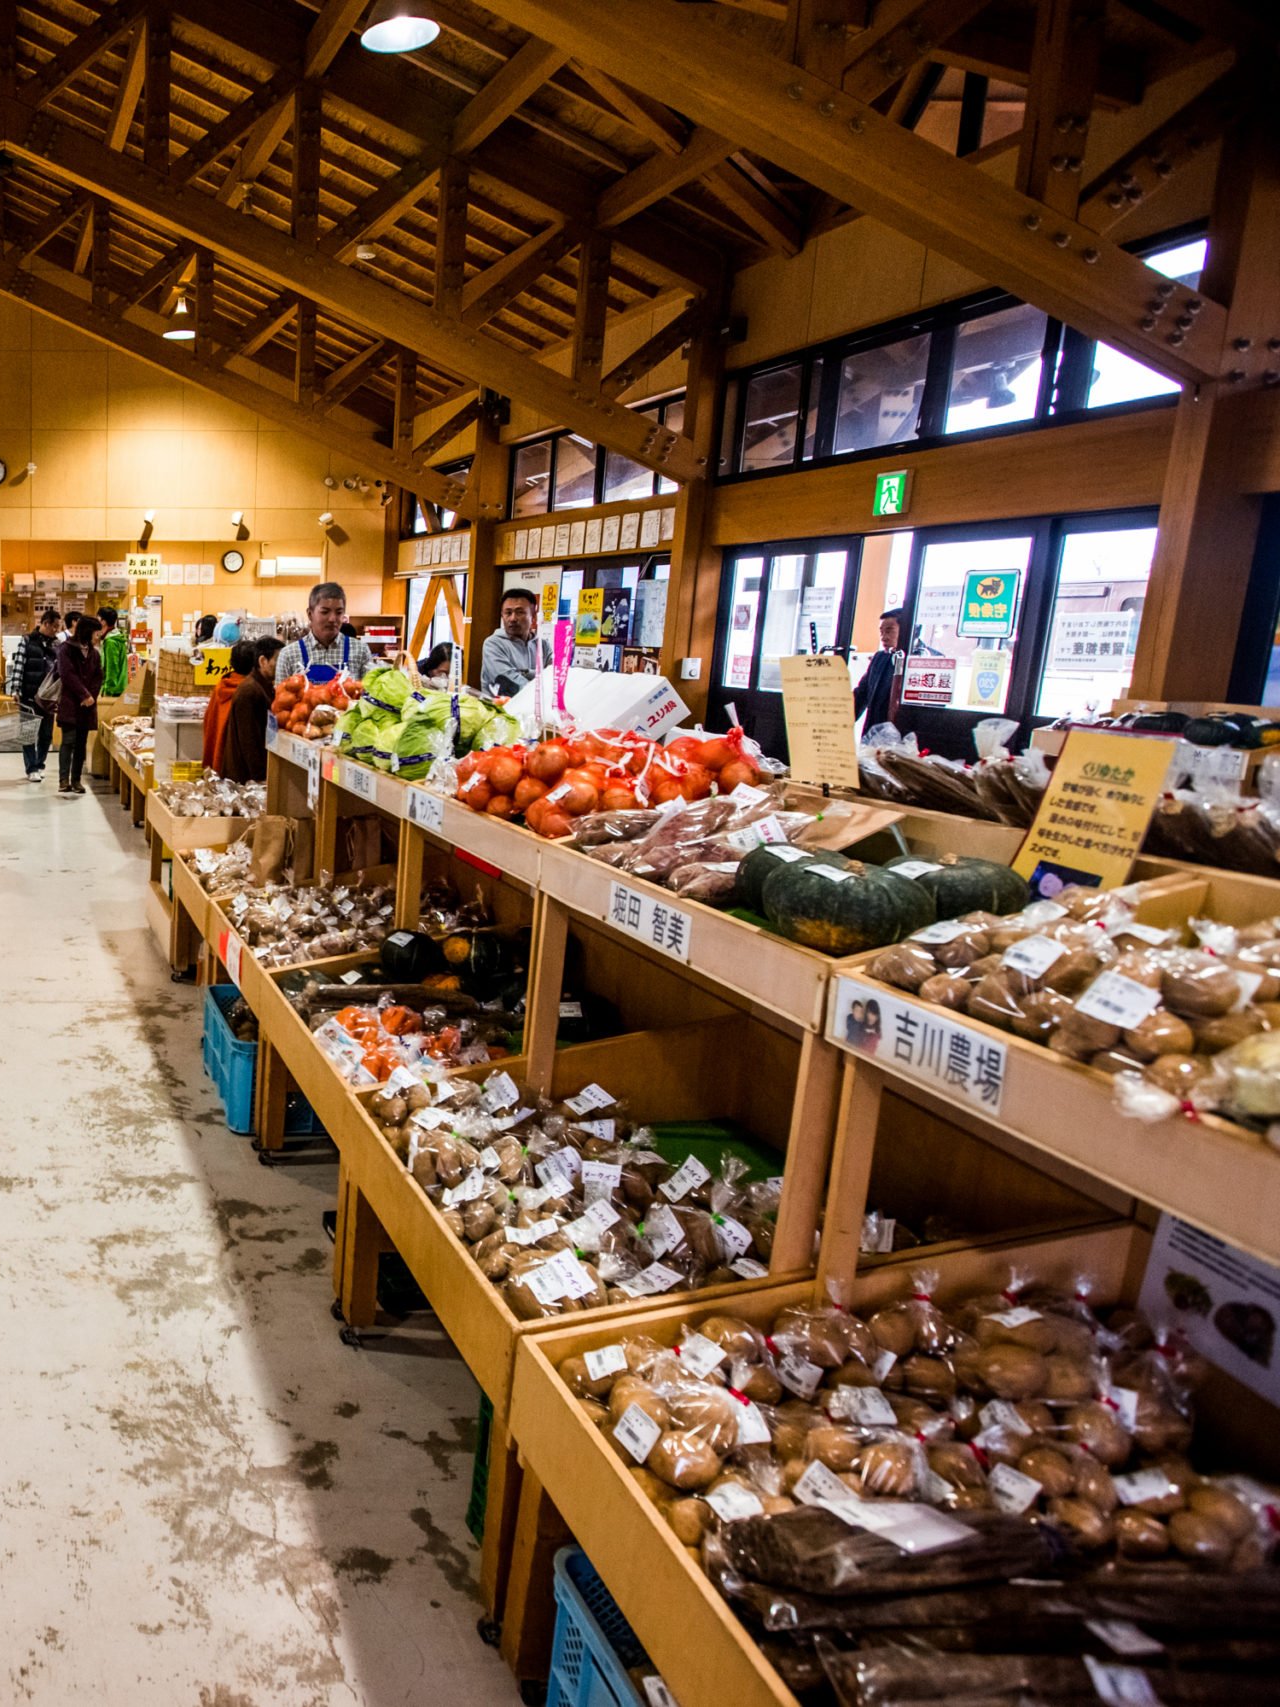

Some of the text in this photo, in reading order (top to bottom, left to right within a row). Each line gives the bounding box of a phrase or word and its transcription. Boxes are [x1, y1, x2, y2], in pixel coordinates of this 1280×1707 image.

[128, 568, 159, 576] CASHIER
[1082, 761, 1136, 782] くりゆたか
[612, 888, 683, 957] 堀田 智美
[894, 1009, 1004, 1106] 吉川農場
[584, 1171, 618, 1181] メークイン
